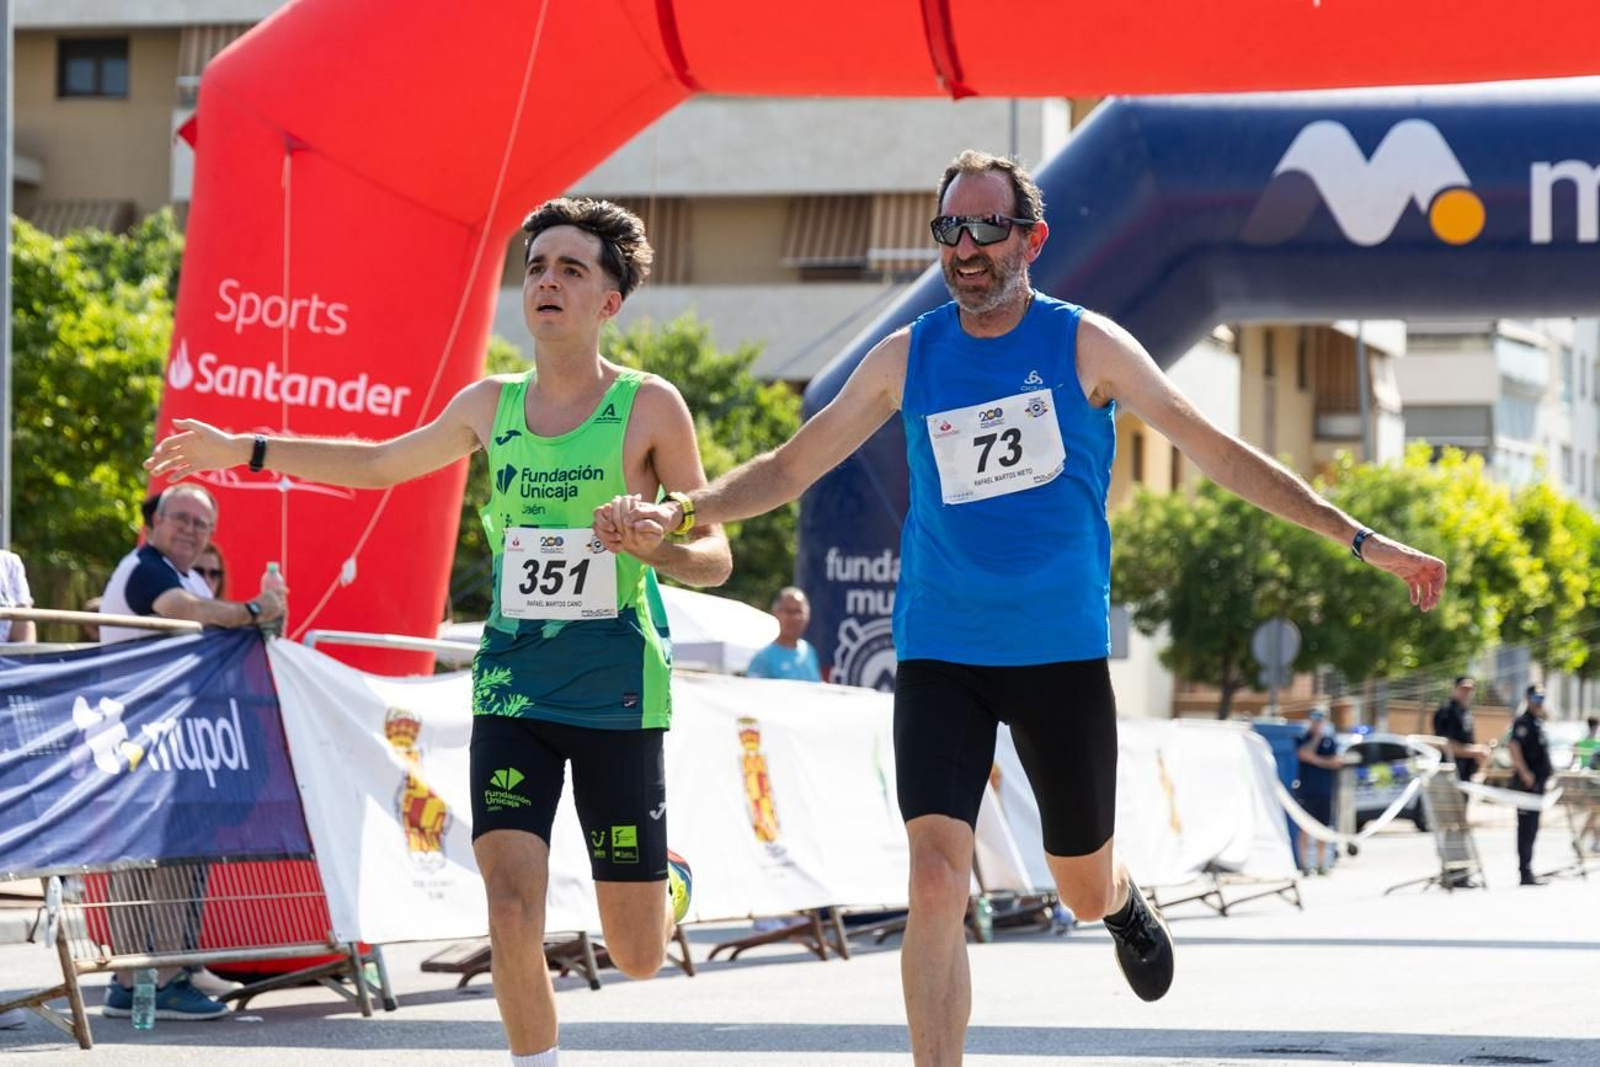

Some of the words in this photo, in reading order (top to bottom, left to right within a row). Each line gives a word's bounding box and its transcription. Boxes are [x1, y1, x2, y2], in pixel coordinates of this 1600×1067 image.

[214, 278, 349, 336] Sports
[195, 352, 411, 416] Santander
[973, 427, 1023, 474] 73
[521, 466, 603, 482] Fundación
[974, 476, 993, 485] RAFAEL
[994, 471, 1016, 482] MARTOS
[1016, 467, 1034, 477] NIETO
[520, 483, 577, 502] Unicaja
[519, 558, 590, 596] 351
[141, 698, 249, 788] mupol
[485, 790, 531, 806] Fundación
[486, 797, 520, 807] Unicaja
